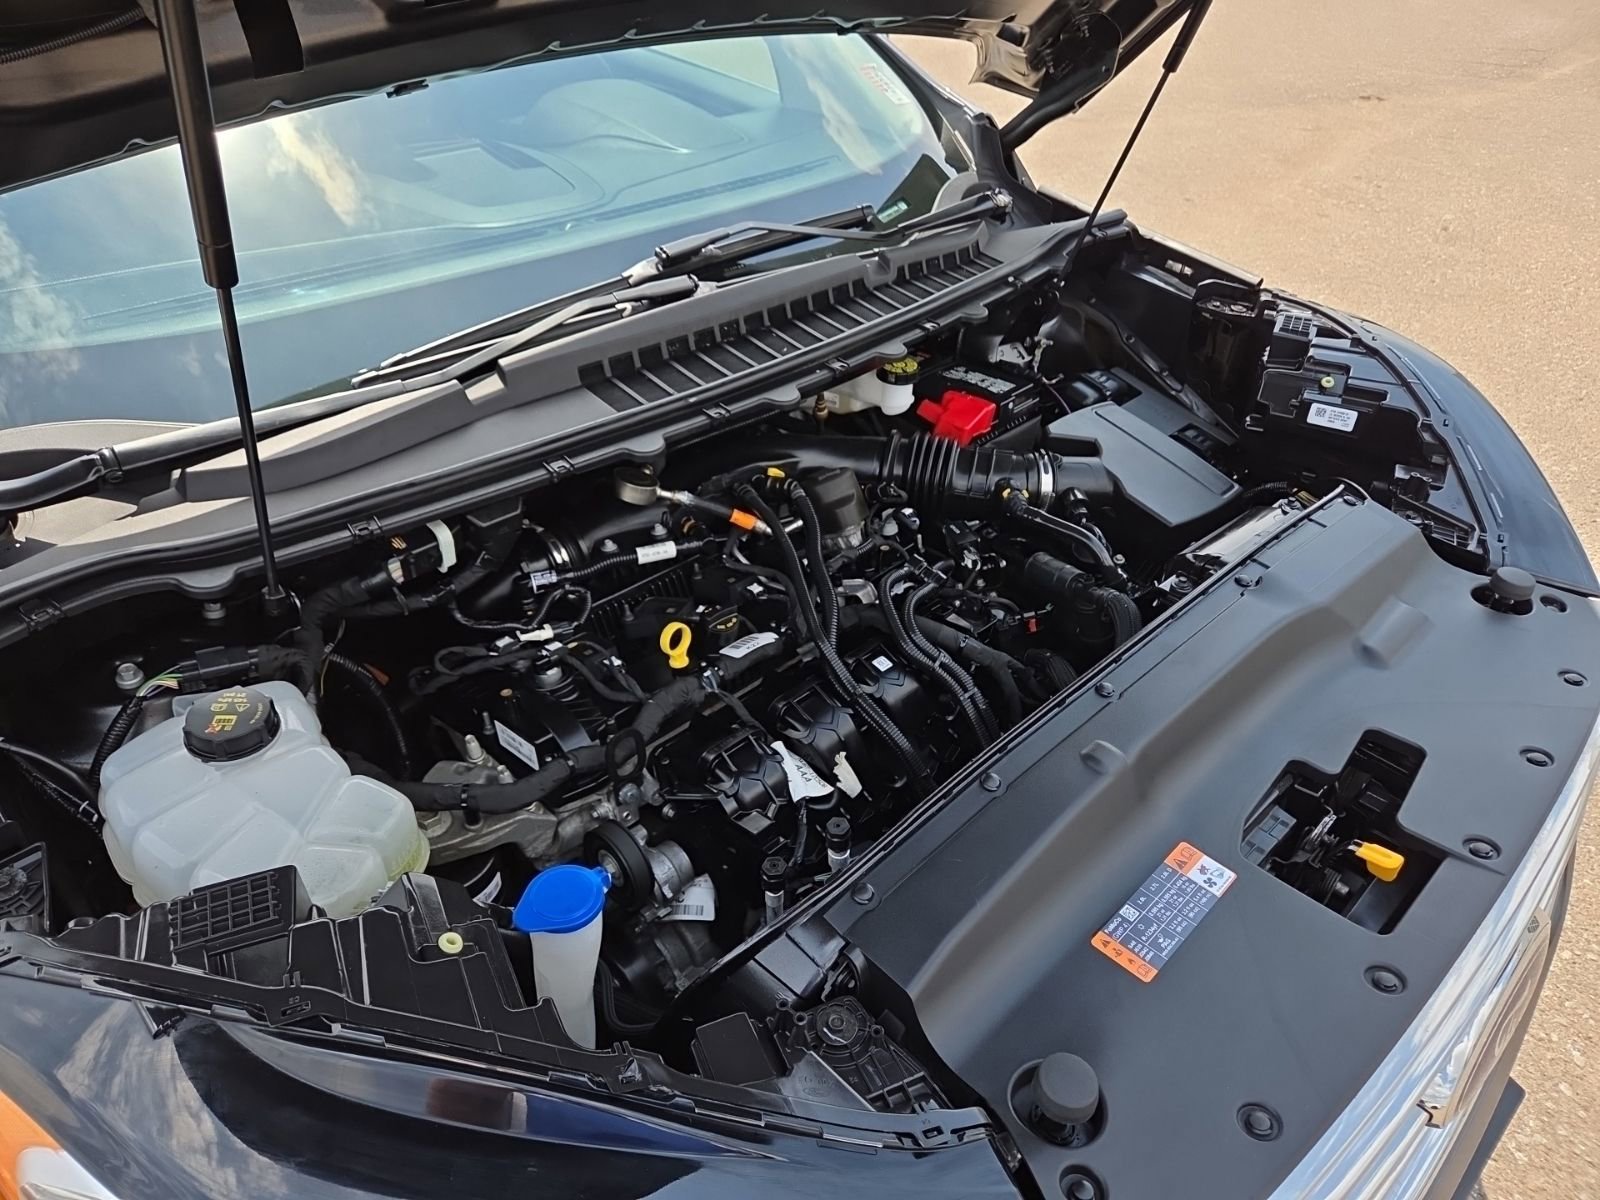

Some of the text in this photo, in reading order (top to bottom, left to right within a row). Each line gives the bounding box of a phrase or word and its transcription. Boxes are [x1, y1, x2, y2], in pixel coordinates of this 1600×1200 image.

[1103, 916, 1122, 934] FoMoCo
[1140, 922, 1159, 941] R-1234yf
[1160, 937, 1171, 948] PAG
